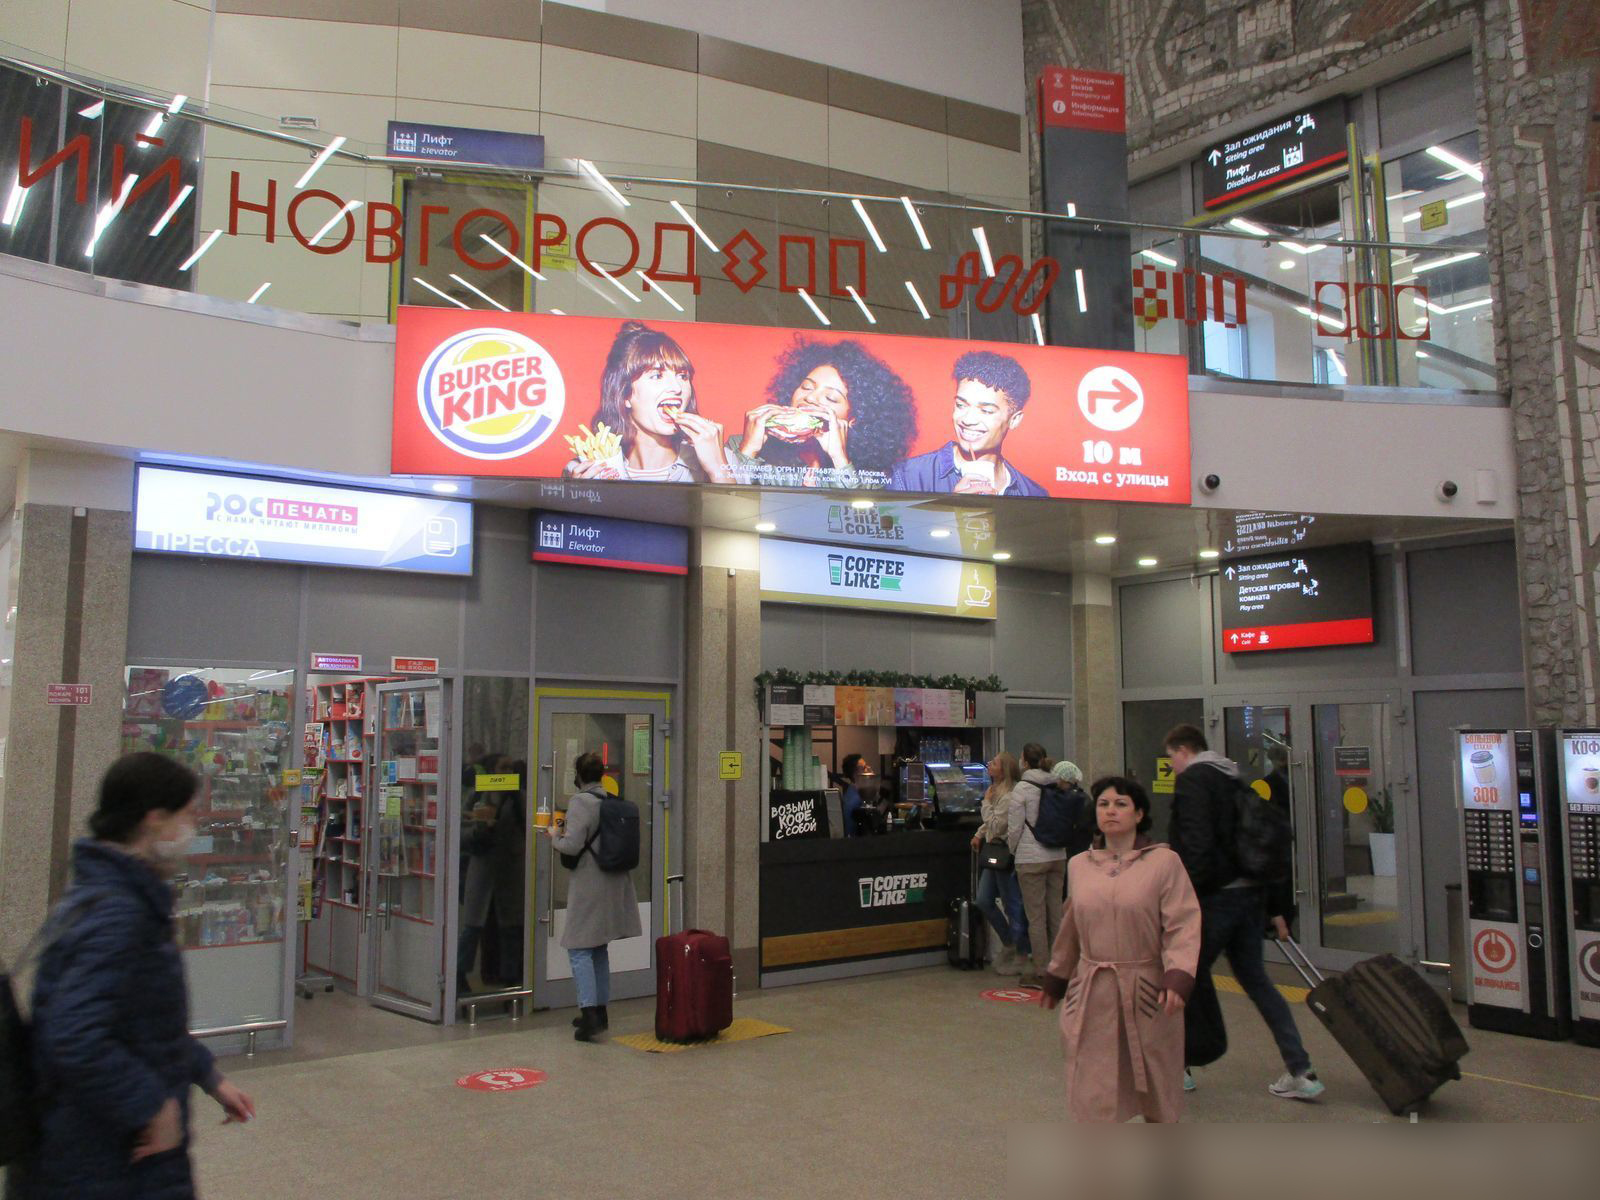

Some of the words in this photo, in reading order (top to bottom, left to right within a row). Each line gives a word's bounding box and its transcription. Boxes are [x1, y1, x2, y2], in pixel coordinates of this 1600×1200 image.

[421, 133, 454, 147] Лифт
[1224, 140, 1241, 154] Зал
[1242, 120, 1292, 147] ожидания
[420, 147, 458, 157] Elevator
[1225, 150, 1248, 165] Sitting
[1248, 143, 1266, 156] area
[1226, 163, 1251, 180] Лифт
[1226, 172, 1257, 191] Disabled
[1256, 164, 1281, 180] Access
[228, 169, 701, 295] НОВГОРОД
[438, 355, 543, 397] BURGER
[442, 376, 547, 429] KING
[1081, 439, 1114, 465] 10
[1055, 466, 1099, 486] Вход
[1102, 472, 1113, 484] с
[1116, 472, 1169, 488] улицы
[226, 514, 255, 525] НАМИ
[259, 517, 300, 530] ЧИТАЮТ
[303, 521, 359, 535] МИЛЛИОНЫ
[569, 524, 601, 541] Лифт
[151, 530, 261, 558] ПРЕССА
[568, 541, 606, 554] Elevator
[845, 555, 905, 577] COFFEE
[1237, 564, 1251, 573] Зал
[1251, 560, 1290, 571] ожидания
[844, 571, 880, 590] LIKE
[1239, 585, 1268, 595] Детская
[1269, 582, 1300, 592] игровая
[1239, 593, 1271, 602] комната
[1239, 604, 1251, 612] Play
[1240, 631, 1256, 639] Кафе
[1473, 786, 1499, 804] 300
[771, 798, 815, 819] ВОЗЬМИ
[775, 829, 785, 840] С
[785, 818, 817, 837] СОБОЙ
[778, 809, 813, 830] КОФЕ
[873, 872, 928, 892] COFFEE
[872, 889, 907, 907] LIKE
